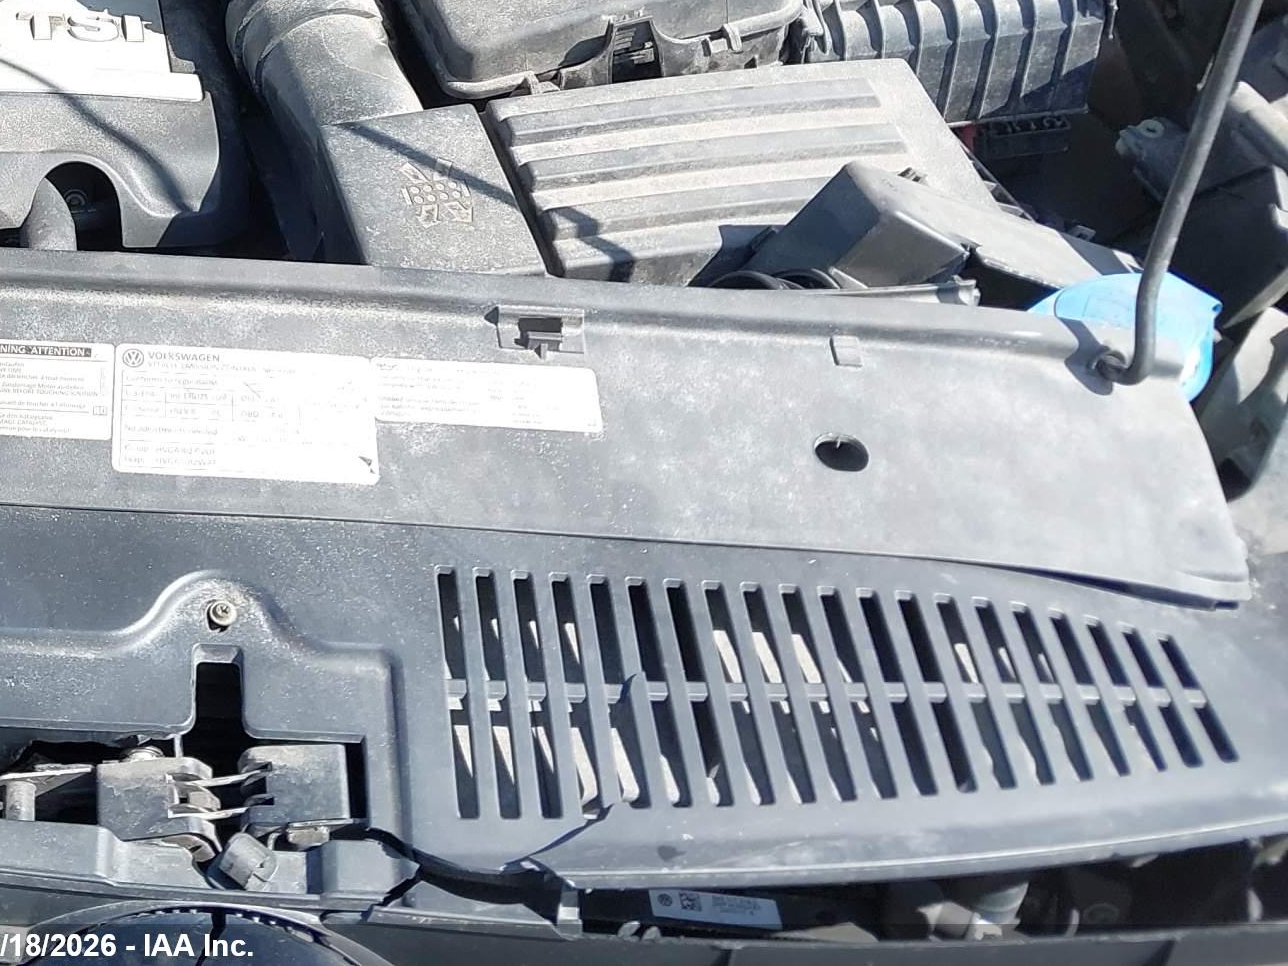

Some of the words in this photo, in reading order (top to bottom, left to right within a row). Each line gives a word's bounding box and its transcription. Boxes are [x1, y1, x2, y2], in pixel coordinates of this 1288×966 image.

[16, 12, 146, 43] TSI
[31, 346, 85, 357] ATTENTION
[148, 351, 221, 362] VOLKSWAGEN
